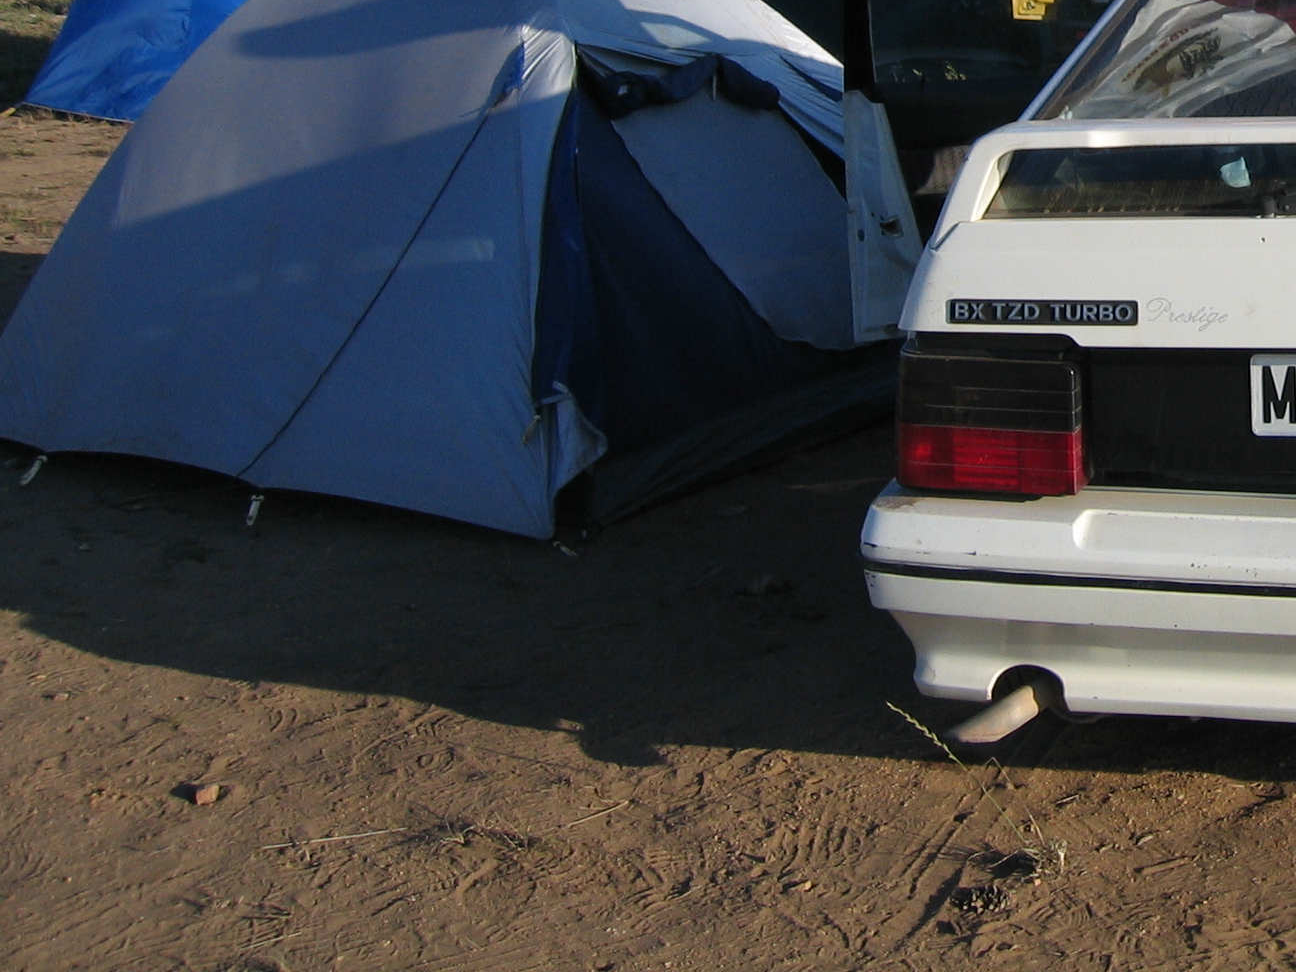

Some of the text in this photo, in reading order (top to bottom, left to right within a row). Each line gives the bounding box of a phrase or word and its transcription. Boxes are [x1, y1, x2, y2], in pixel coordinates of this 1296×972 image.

[953, 301, 1134, 323] BX TZD TURBO
[1146, 297, 1228, 332] Prestige
